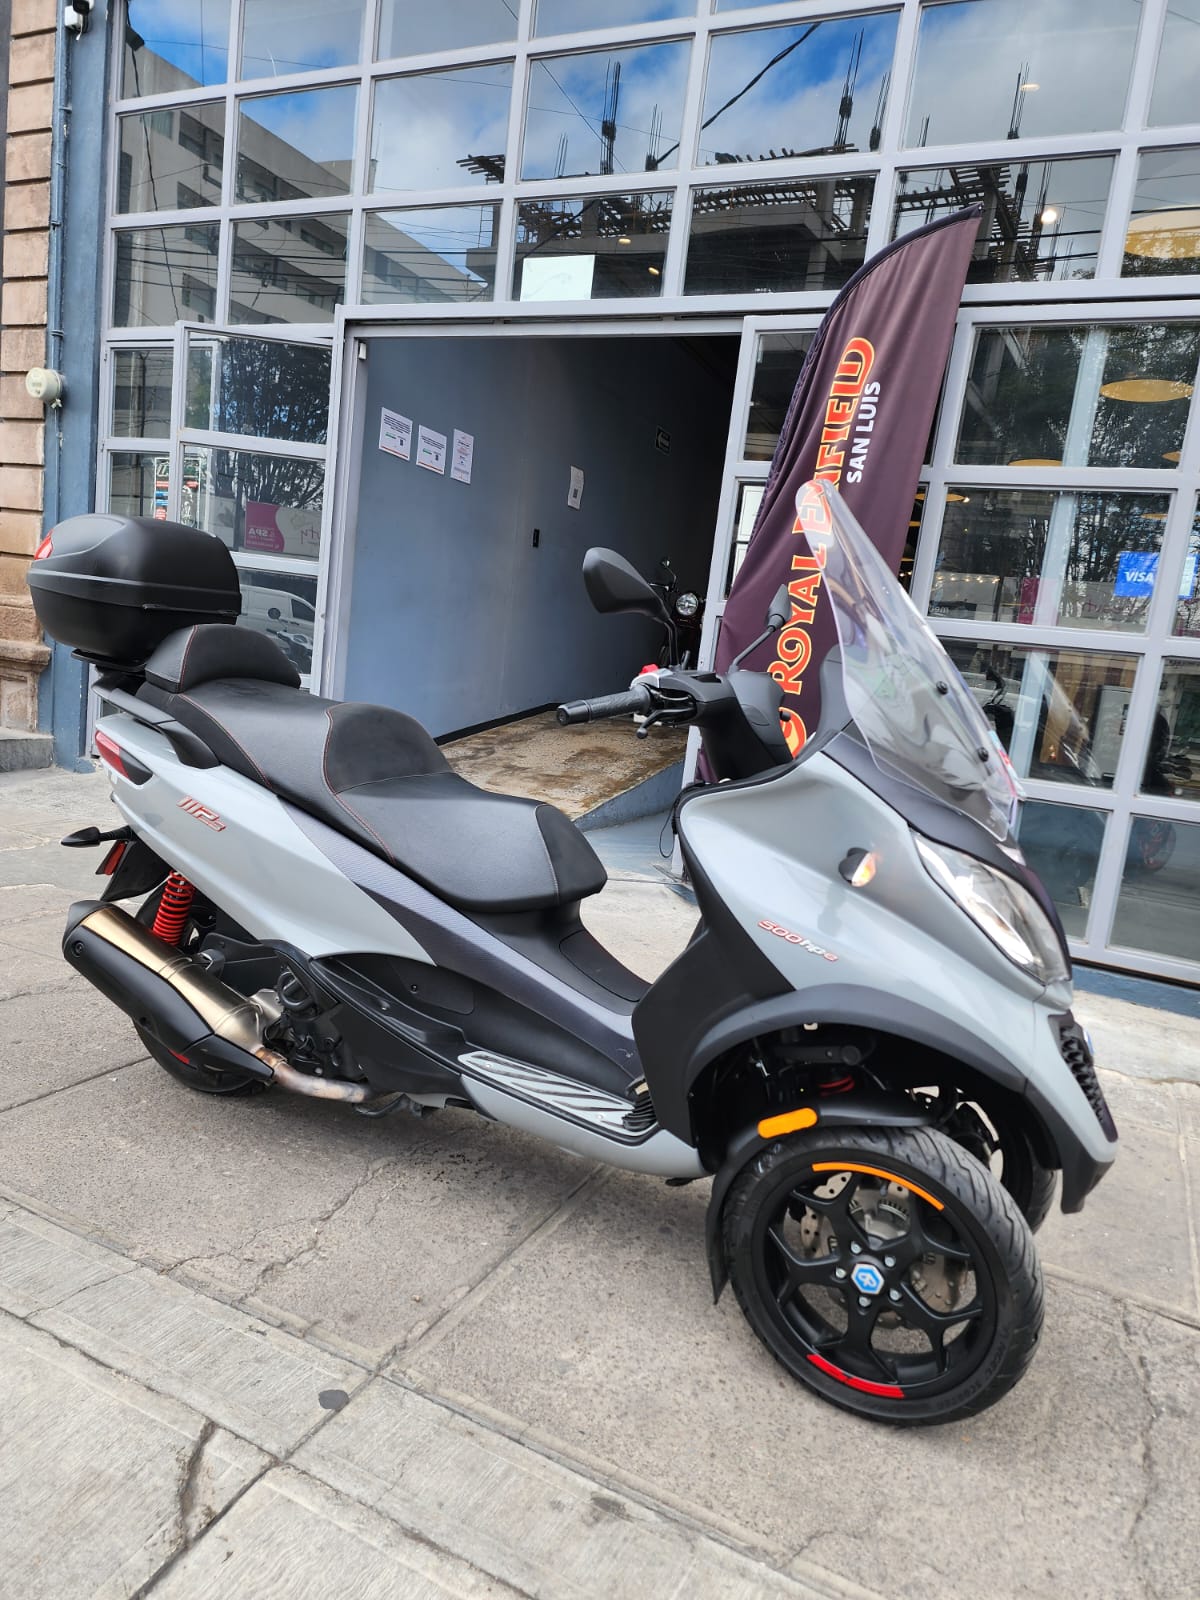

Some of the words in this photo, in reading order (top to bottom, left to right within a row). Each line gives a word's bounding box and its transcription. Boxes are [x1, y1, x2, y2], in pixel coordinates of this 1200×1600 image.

[856, 381, 881, 432] LUIS
[847, 438, 871, 483] SAN
[1124, 571, 1155, 583] VISA
[767, 544, 827, 695] ROYAL
